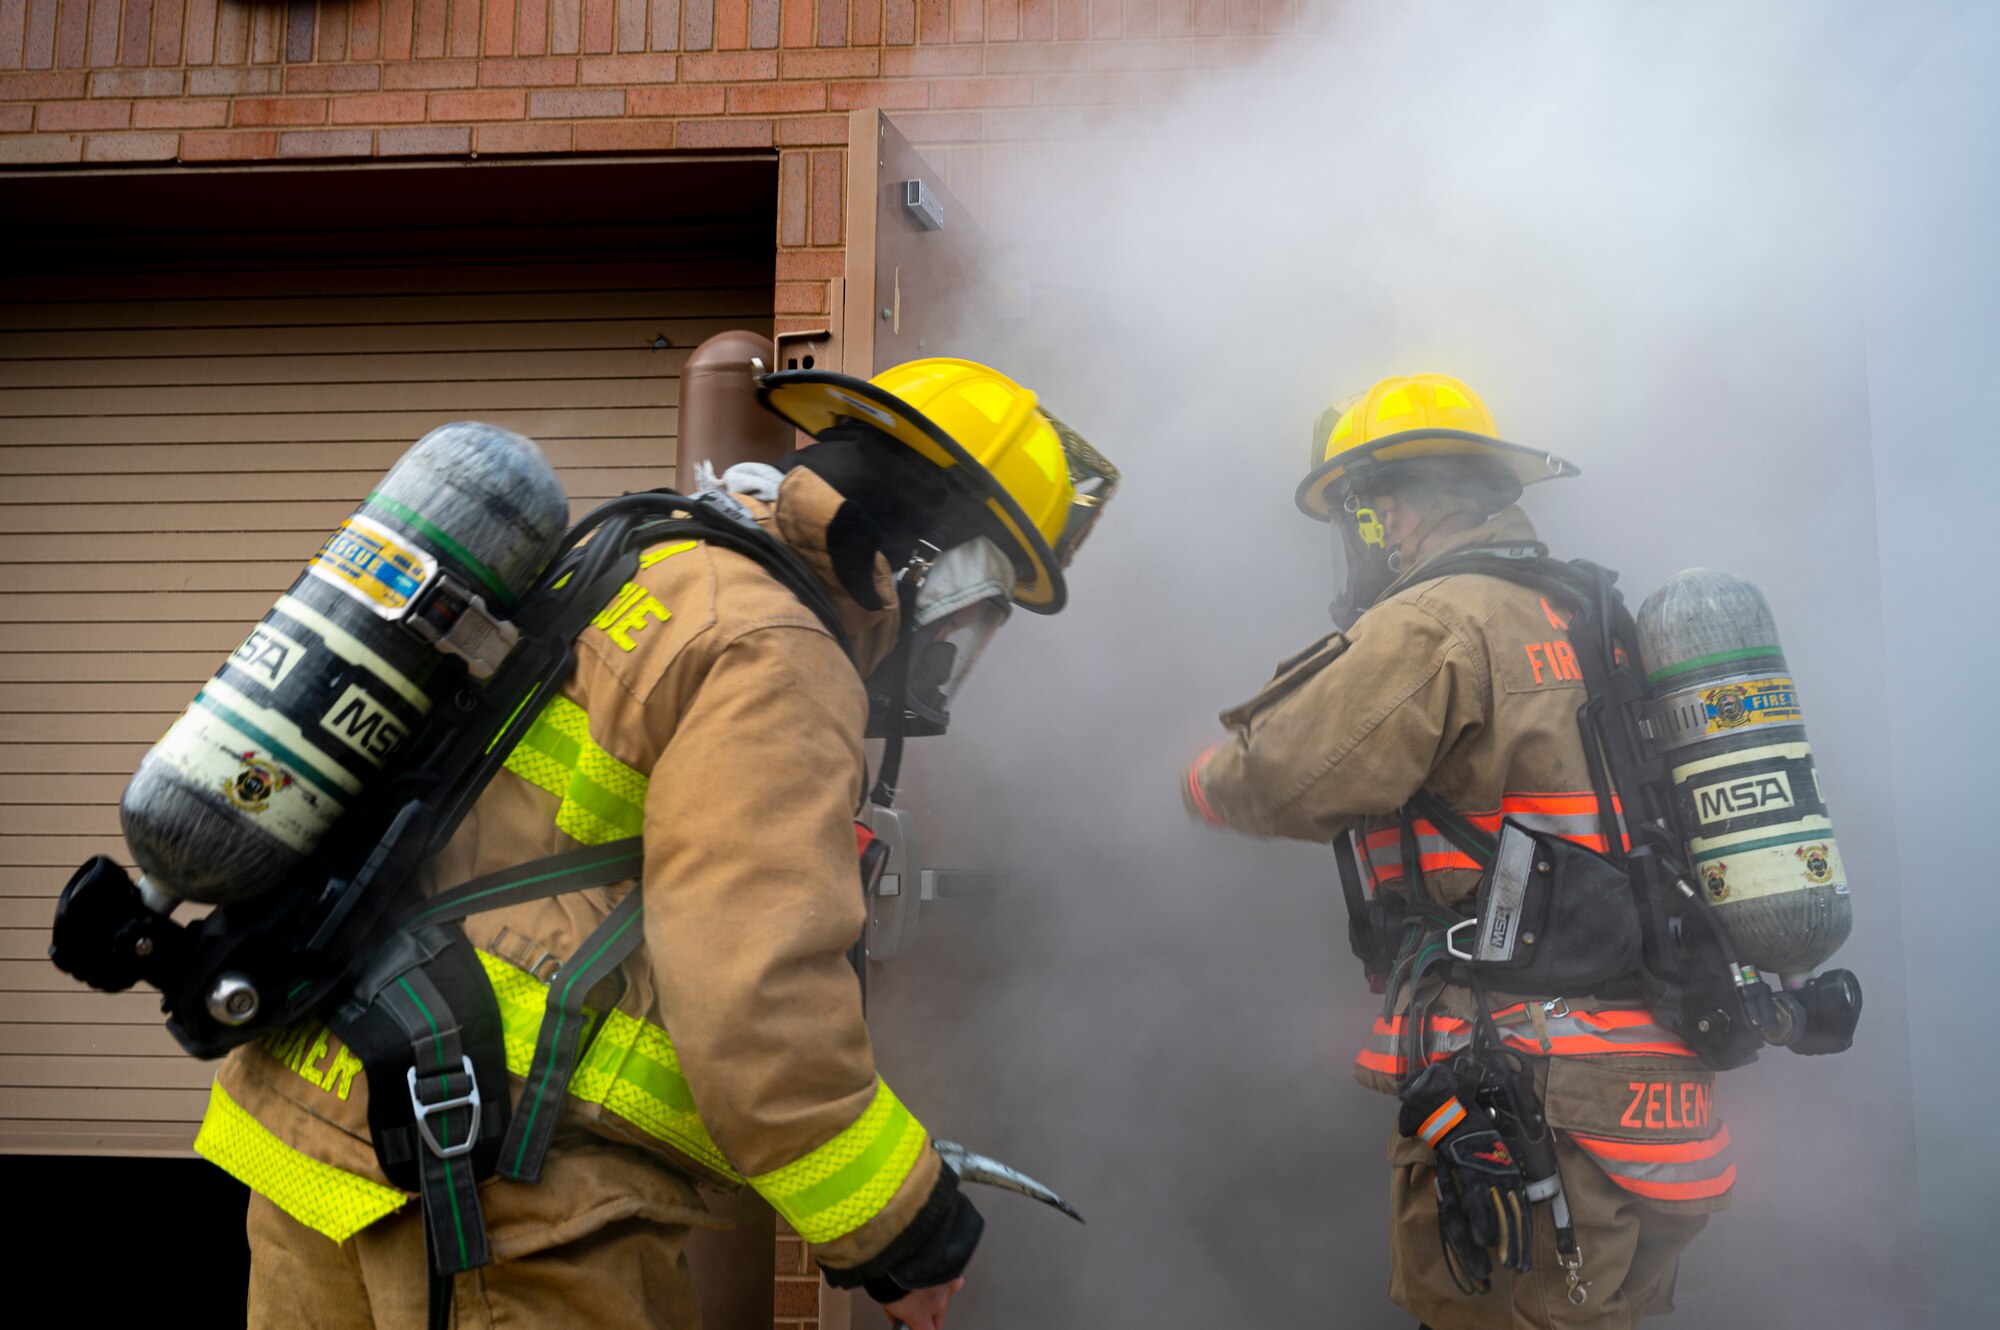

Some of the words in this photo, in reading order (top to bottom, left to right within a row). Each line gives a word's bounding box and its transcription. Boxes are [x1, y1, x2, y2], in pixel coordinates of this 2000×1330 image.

[235, 631, 290, 681] SA
[1751, 693, 1786, 709] FIRE
[331, 697, 399, 759] MS
[1701, 777, 1790, 819] MSA
